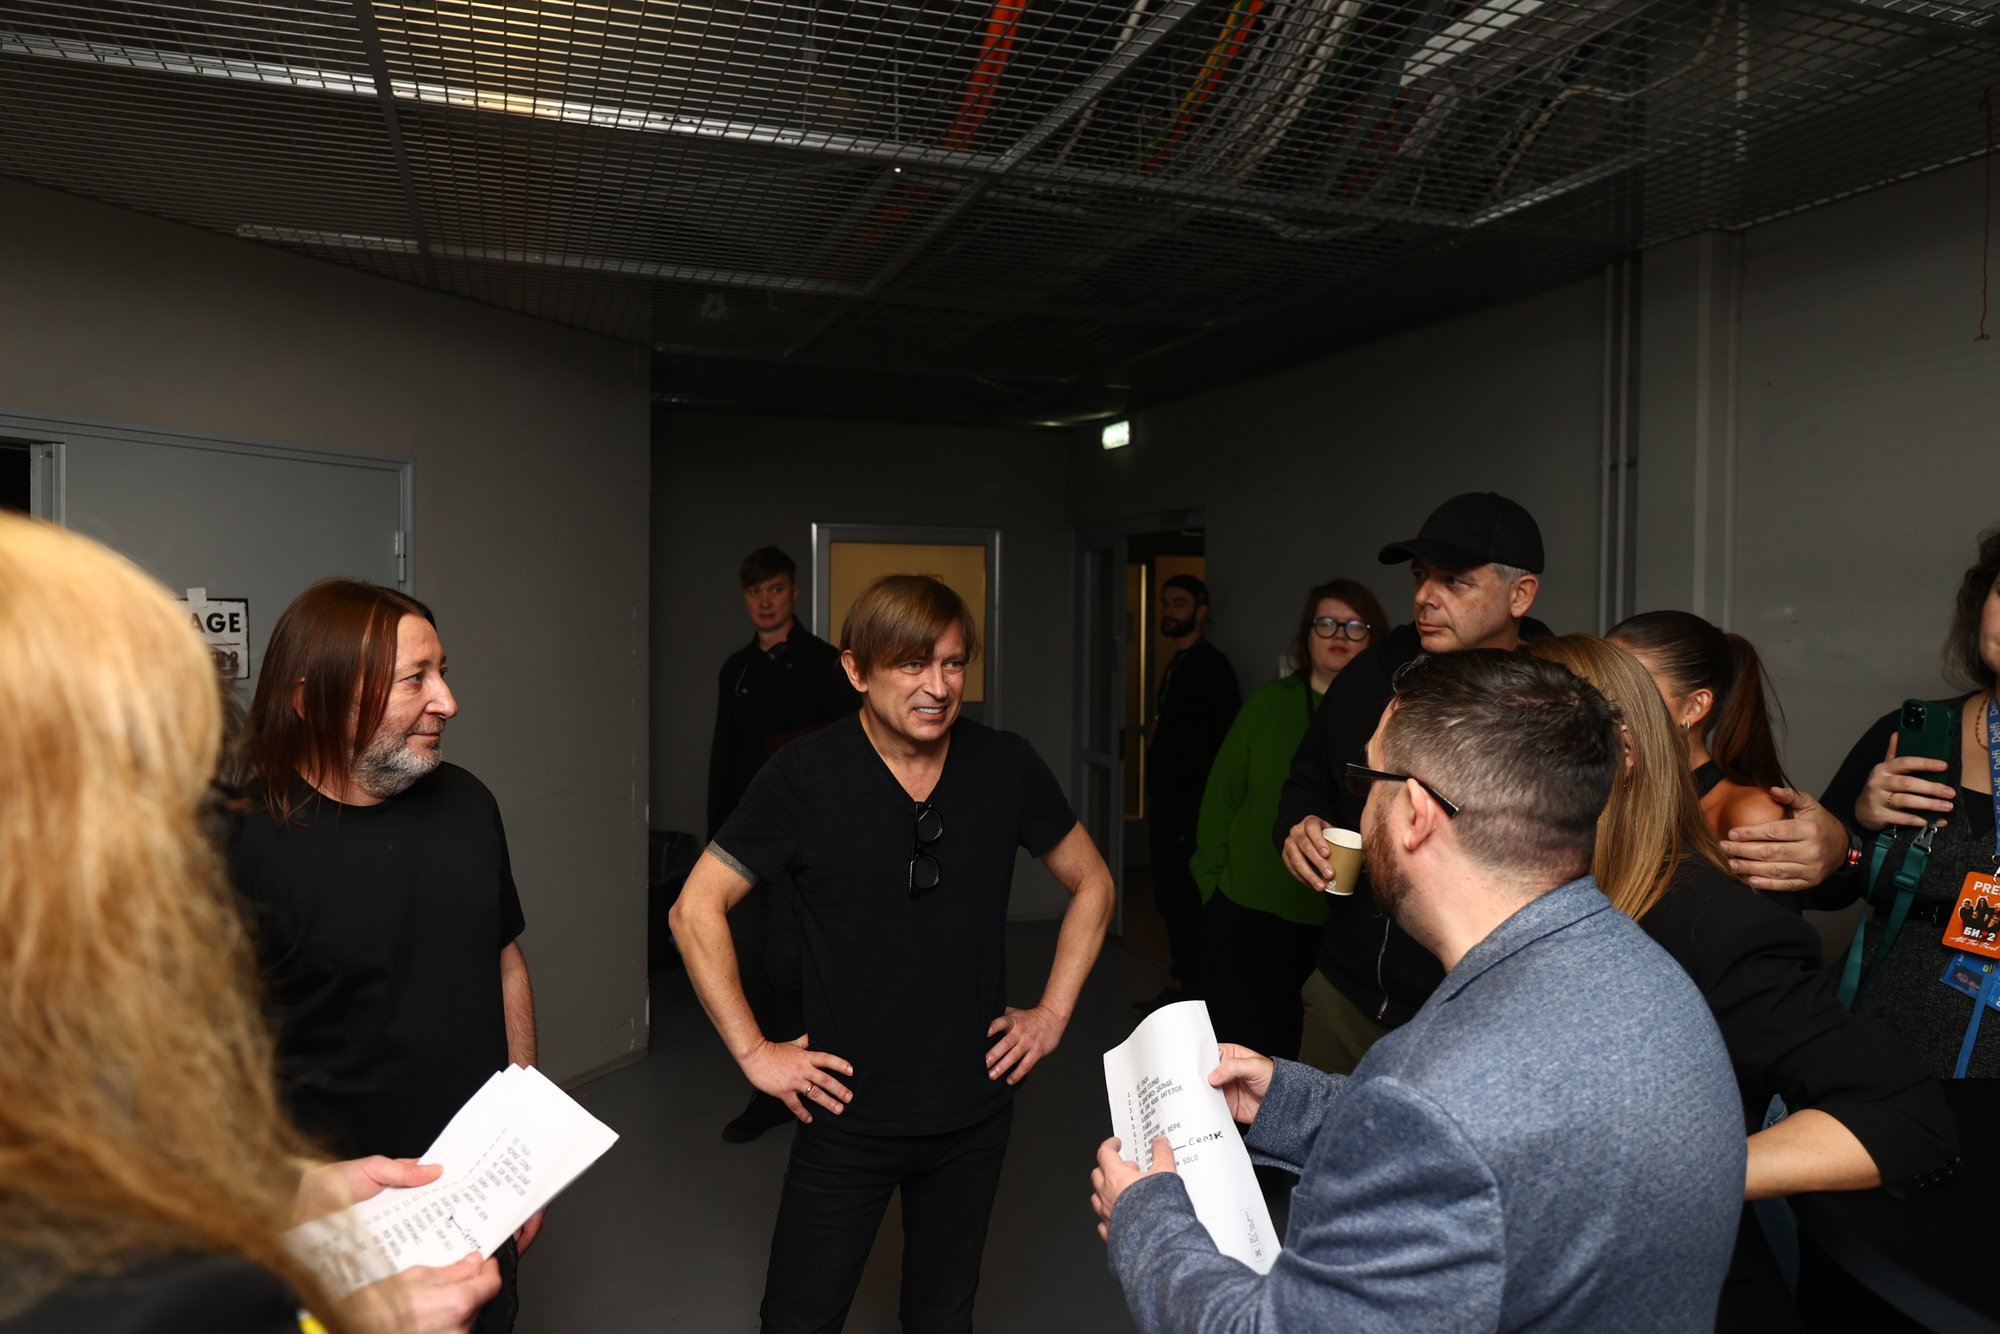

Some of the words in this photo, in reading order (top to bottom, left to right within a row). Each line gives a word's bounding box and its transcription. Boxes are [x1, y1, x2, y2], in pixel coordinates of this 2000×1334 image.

[191, 612, 241, 633] AGE
[1990, 721, 2000, 743] Delfi
[1973, 881, 2000, 896] PRE
[1182, 1154, 1199, 1165] SOLO
